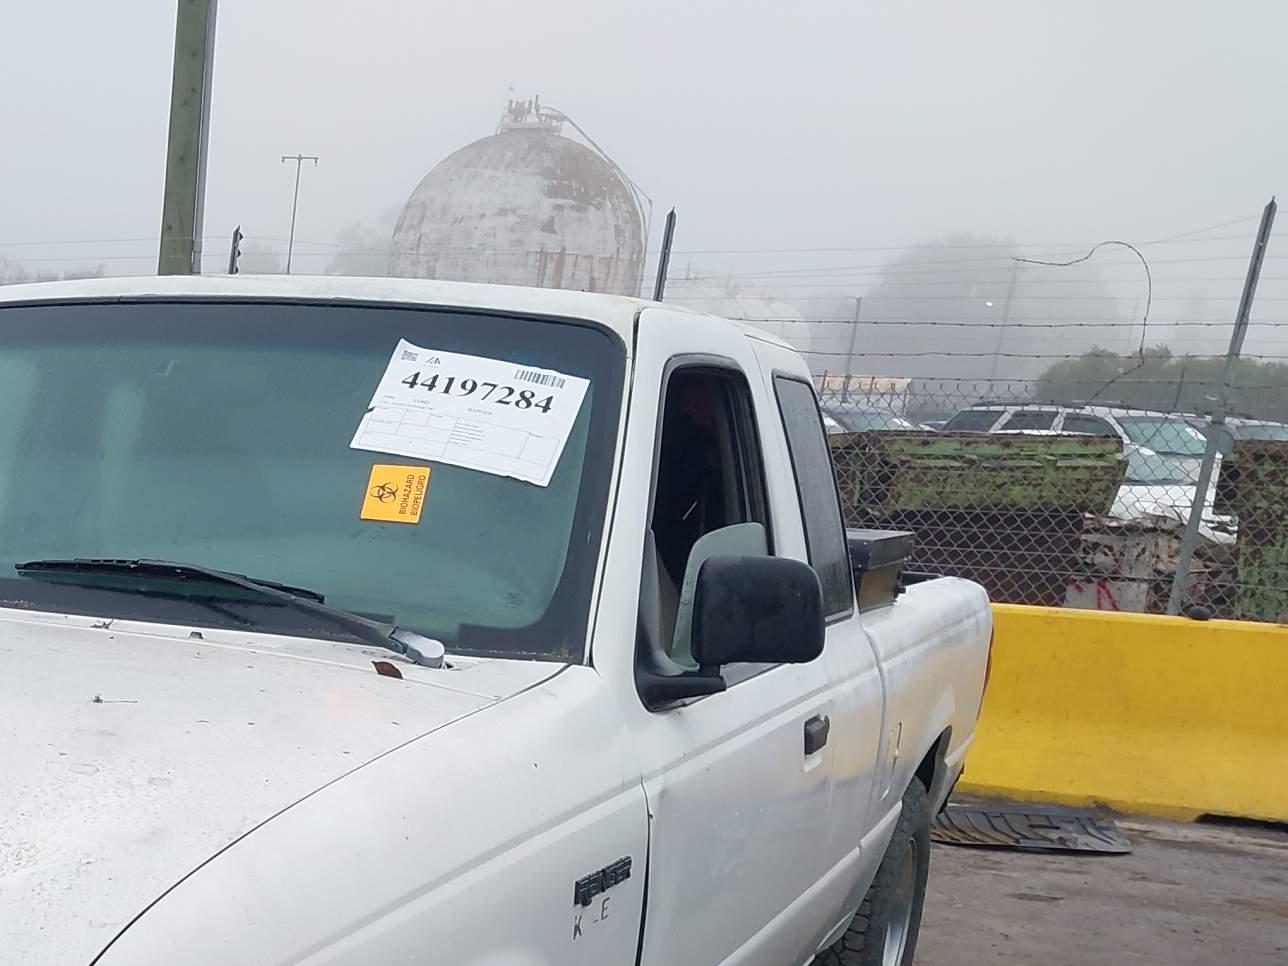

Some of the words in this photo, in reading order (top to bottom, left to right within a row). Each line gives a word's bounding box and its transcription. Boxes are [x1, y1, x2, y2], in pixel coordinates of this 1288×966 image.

[400, 371, 555, 414] 44197284
[398, 474, 415, 515] BIOHAZARD
[410, 475, 427, 516] BIOPELIGRO
